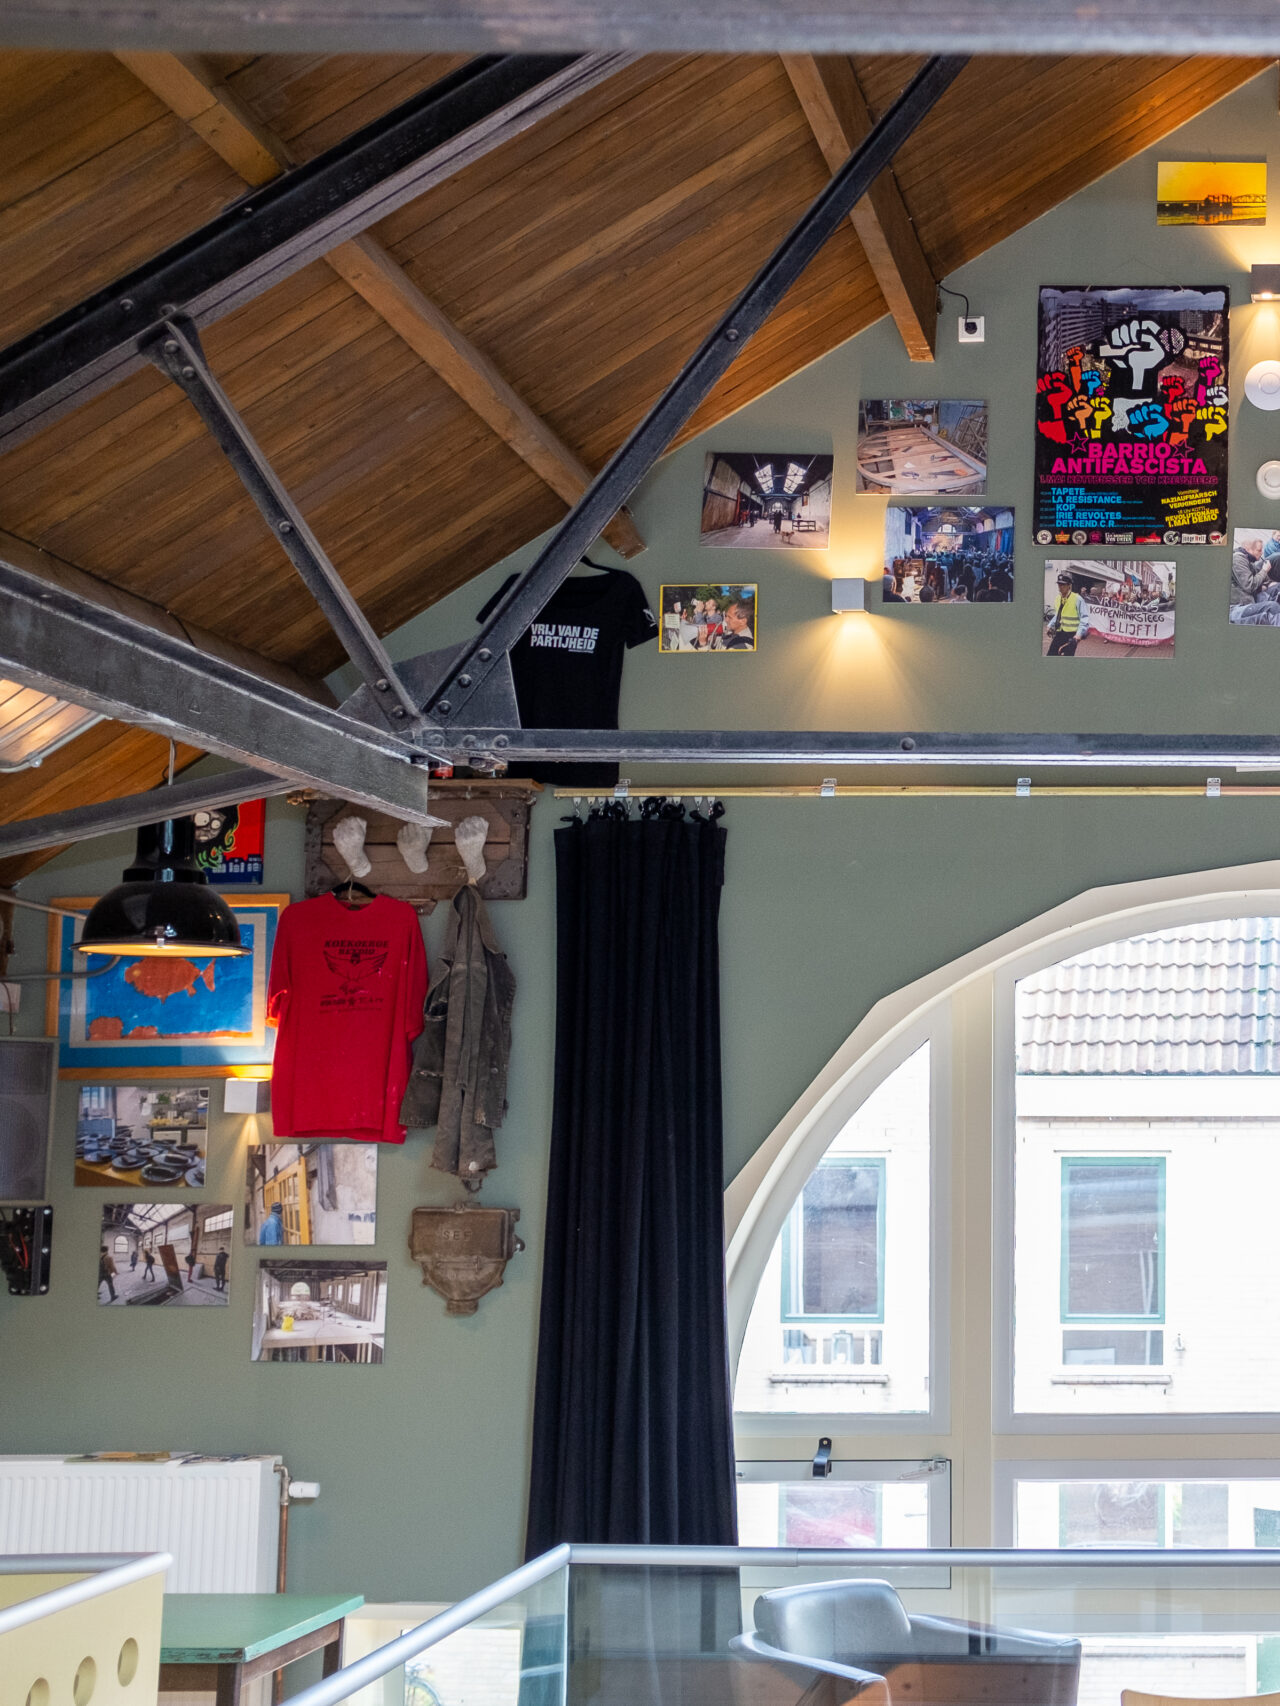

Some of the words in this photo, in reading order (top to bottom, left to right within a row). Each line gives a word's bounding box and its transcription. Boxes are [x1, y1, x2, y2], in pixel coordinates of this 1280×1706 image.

[1088, 442, 1171, 458] BARRIO
[1051, 458, 1207, 474] ANTIFASCISTA
[1136, 476, 1156, 484] TOR
[1161, 491, 1217, 504] NAZIAUFMARSCH
[1169, 498, 1211, 509] VERHINDERN
[1192, 514, 1218, 524] DEMO
[531, 624, 556, 636] VRIJ
[558, 624, 581, 637] VAN
[583, 627, 599, 640] DE
[1110, 620, 1158, 636] BLIJFT!
[530, 636, 596, 650] PARTIJHEID
